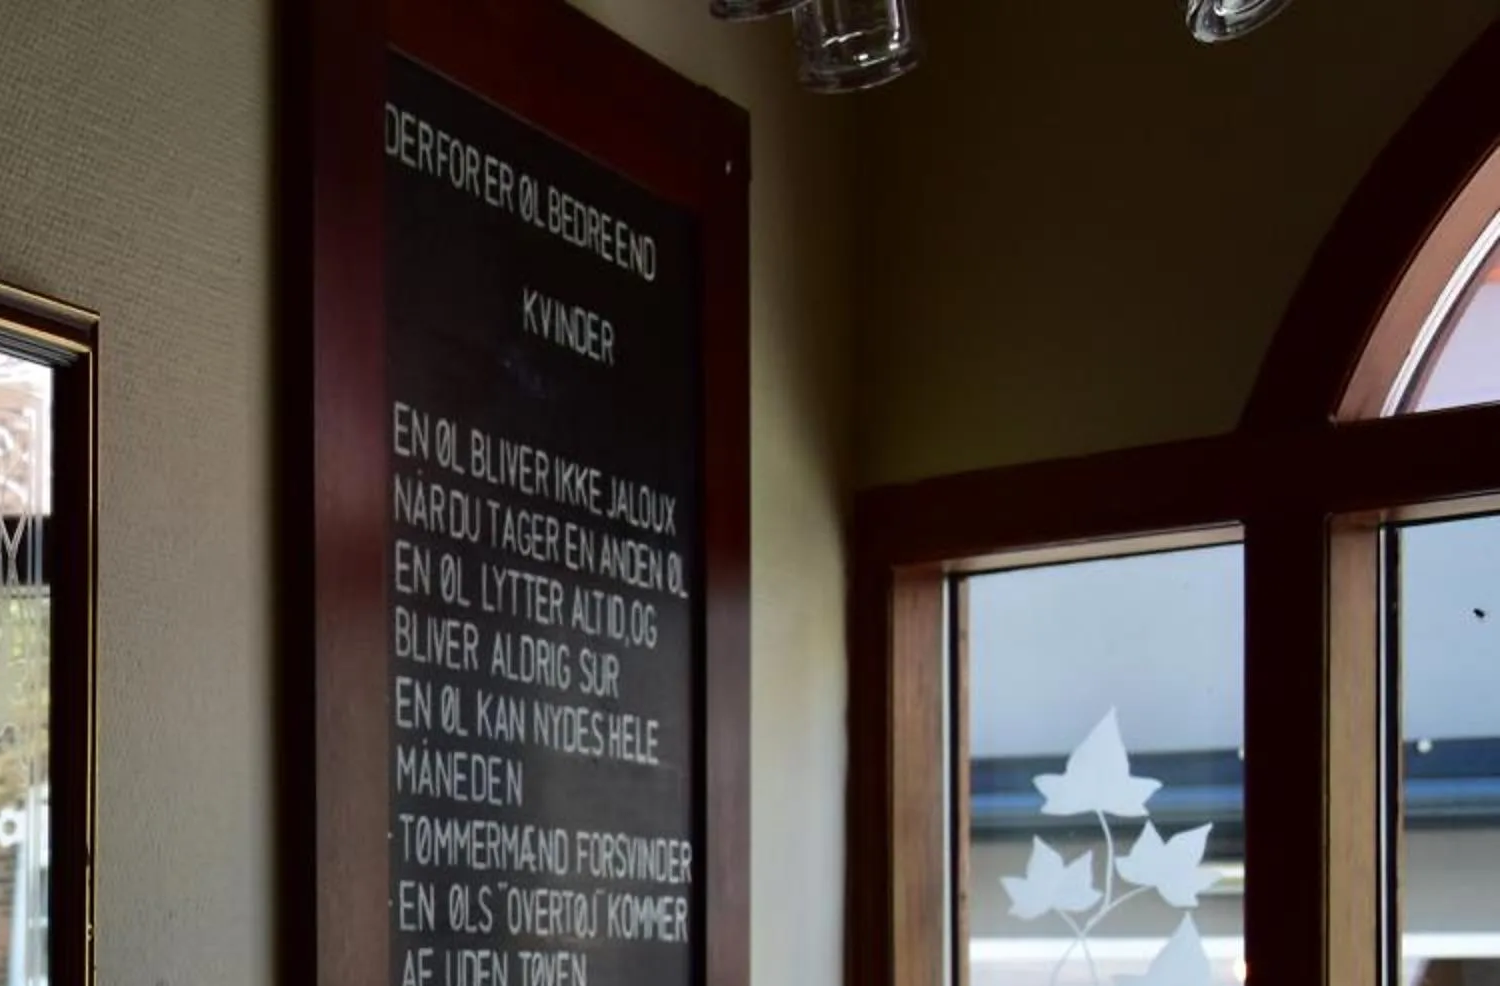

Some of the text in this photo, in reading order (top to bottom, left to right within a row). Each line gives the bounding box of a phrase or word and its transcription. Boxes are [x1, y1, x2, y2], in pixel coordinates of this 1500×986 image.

[385, 101, 657, 282] DERFOR ER ØL BEDRE END
[522, 286, 615, 367] KVINDER
[393, 400, 677, 537] EN ØL BLIVER IKKE JALOUX
[393, 467, 446, 535] NÅR
[449, 490, 481, 544] DU
[486, 498, 560, 563] TAGER
[565, 521, 595, 575] EN
[600, 532, 664, 594] ANDEN
[394, 539, 431, 597] EN
[440, 552, 471, 609] ØL
[481, 560, 564, 626] LYTTER
[394, 604, 620, 700] BLIVER ALDRIG SUR
[395, 675, 660, 766] EN ØL KAN NYDES HELE
[396, 736, 524, 808] MÅNEDEN
[575, 831, 693, 884] FORSVINDER
[399, 880, 436, 933] EN
[449, 883, 494, 935] ØLS
[607, 892, 689, 944] KOMMER
